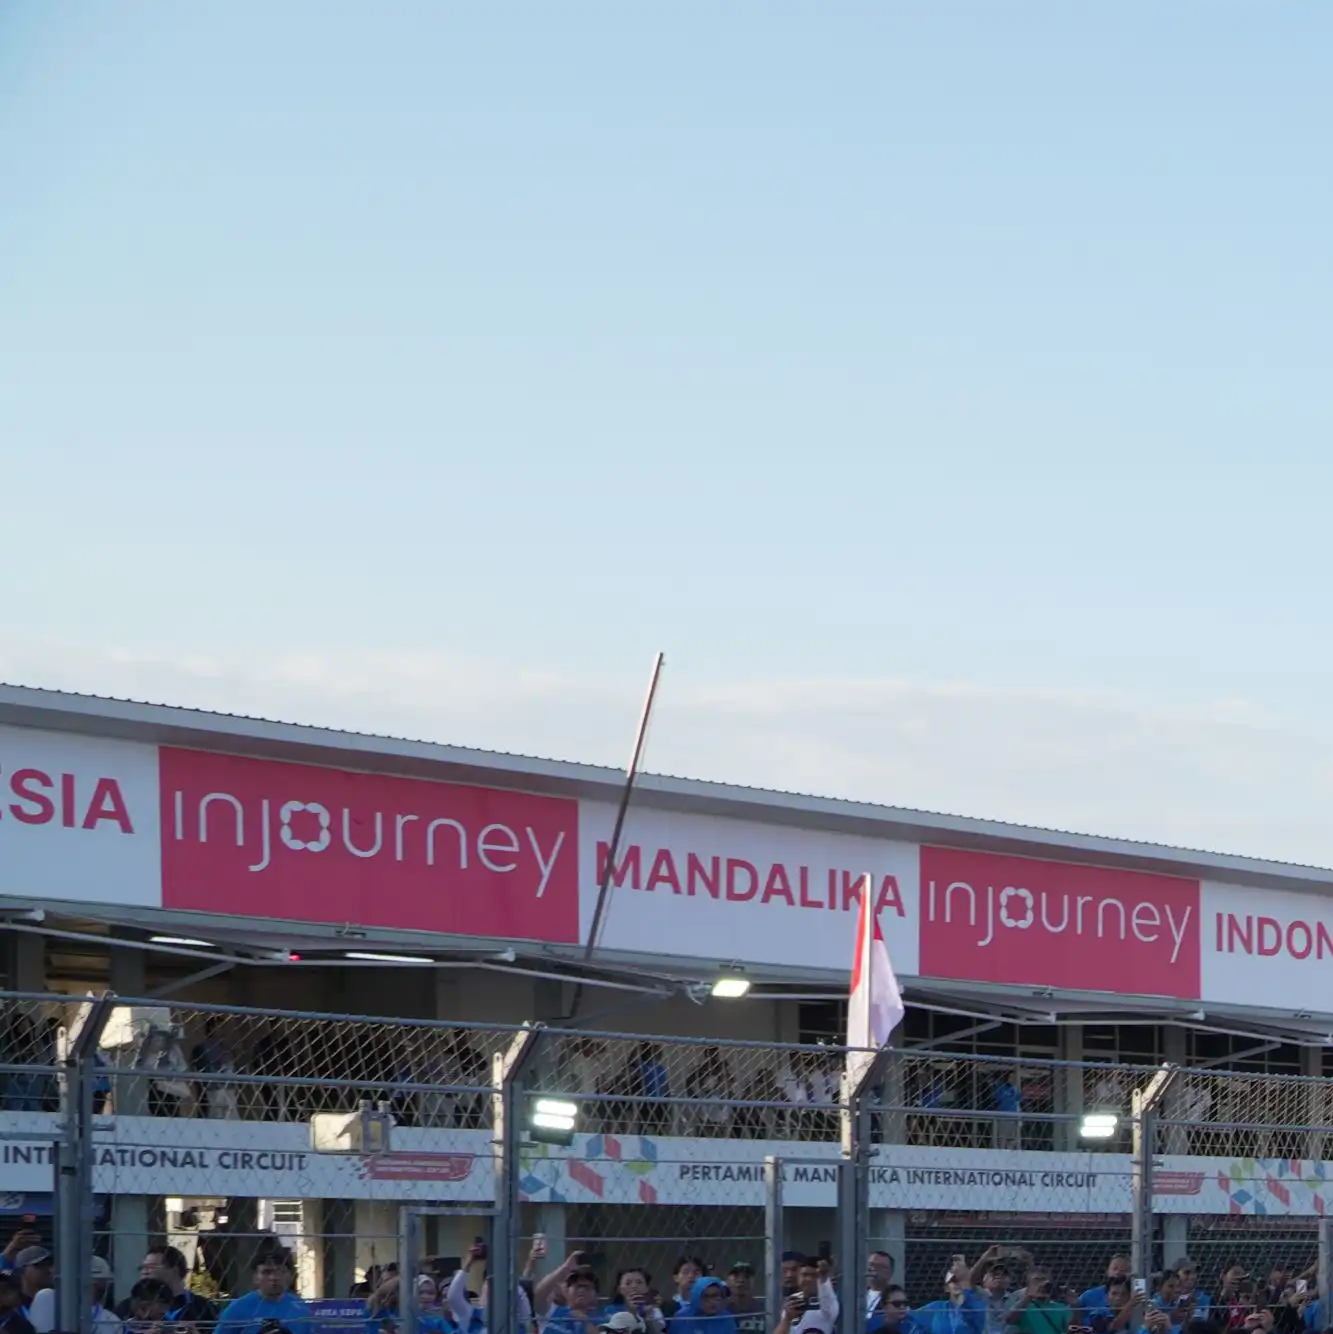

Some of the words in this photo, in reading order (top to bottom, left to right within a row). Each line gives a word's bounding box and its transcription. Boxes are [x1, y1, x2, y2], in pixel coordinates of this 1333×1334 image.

[0, 768, 135, 834] SIA
[174, 790, 565, 897] injourney
[596, 841, 906, 918] MANDALIKA
[928, 880, 1192, 963] injourney
[4, 1145, 208, 1169] INTATIONAL
[218, 1152, 306, 1171] CIRCUIT
[679, 1164, 787, 1182] PERTAMIA
[793, 1167, 900, 1184] MANIKA
[907, 1169, 1036, 1188] INTERNATIONAL
[1042, 1172, 1098, 1188] CIRCUIT
